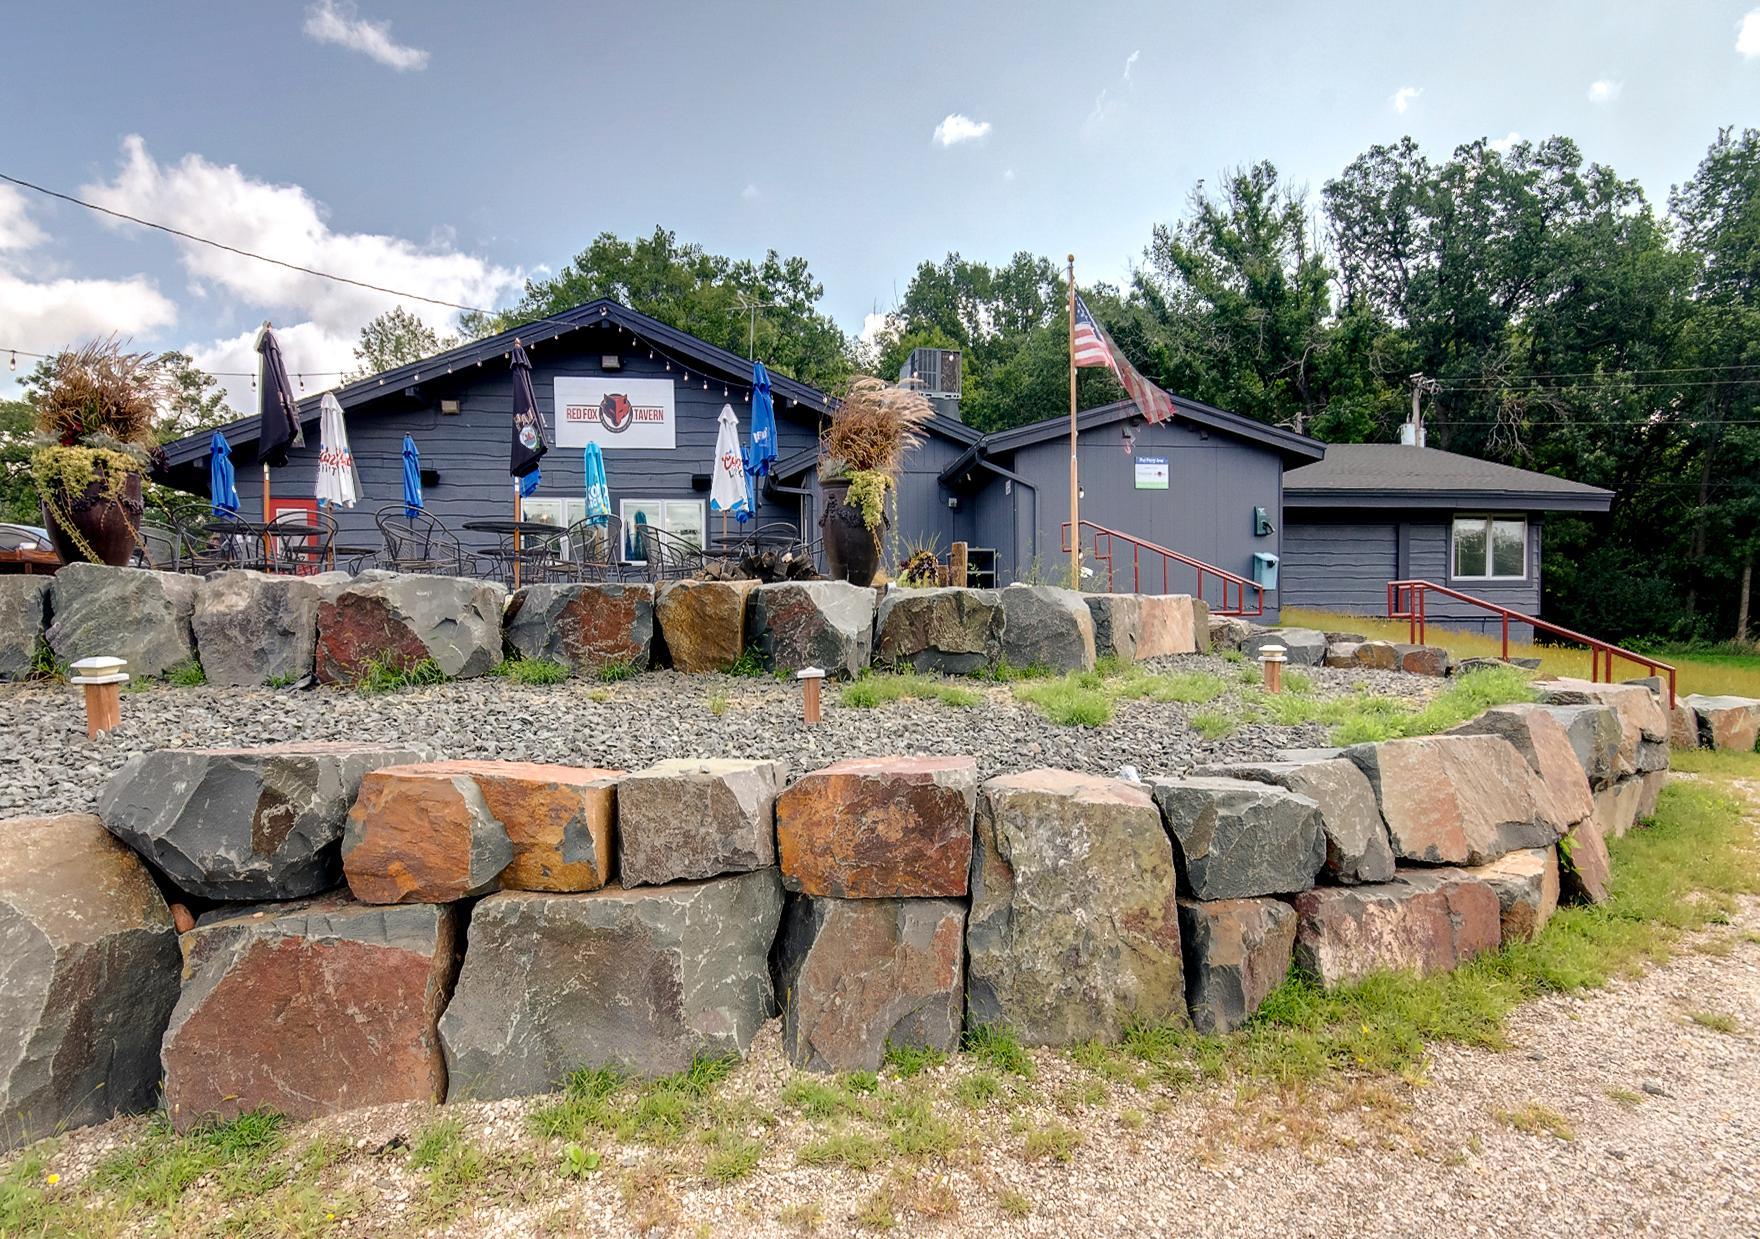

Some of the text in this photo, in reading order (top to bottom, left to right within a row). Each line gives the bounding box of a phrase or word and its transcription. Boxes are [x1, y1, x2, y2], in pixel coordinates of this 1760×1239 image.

[566, 408, 664, 421] RED FOX TAVERN
